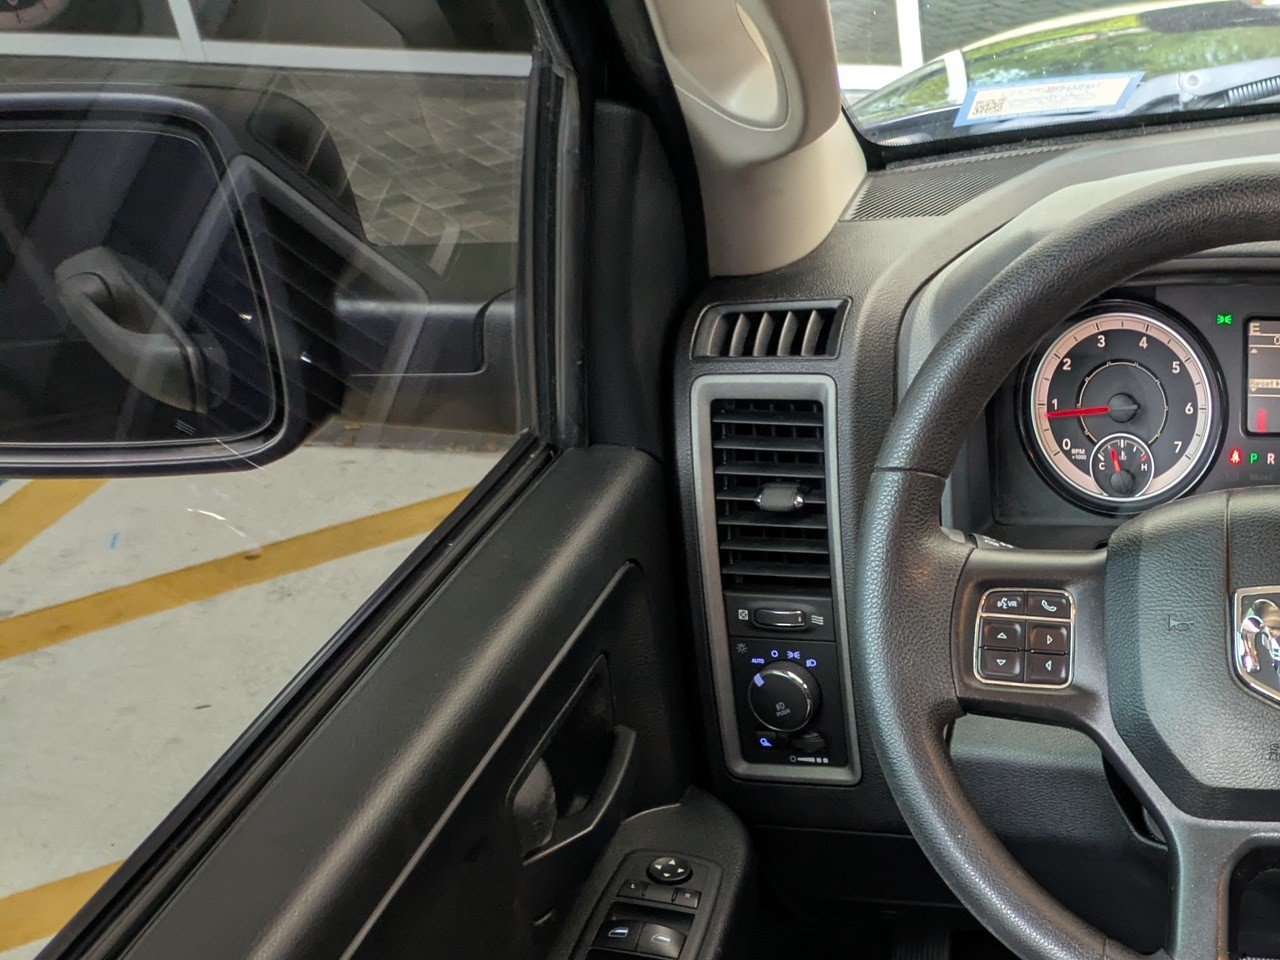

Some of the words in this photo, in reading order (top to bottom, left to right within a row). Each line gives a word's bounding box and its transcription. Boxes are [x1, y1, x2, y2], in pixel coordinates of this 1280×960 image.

[1249, 322, 1260, 335] E
[1097, 335, 1105, 348] 3
[1139, 336, 1148, 349] 4
[1062, 358, 1072, 371] 2
[1172, 361, 1180, 373] 5
[1052, 399, 1058, 410] 1
[1185, 403, 1194, 414] 6
[1062, 438, 1071, 450] 0
[1174, 441, 1182, 454] 7
[1250, 453, 1257, 464] P
[1267, 453, 1275, 464] R
[1099, 462, 1106, 470] C
[1141, 463, 1147, 471] H
